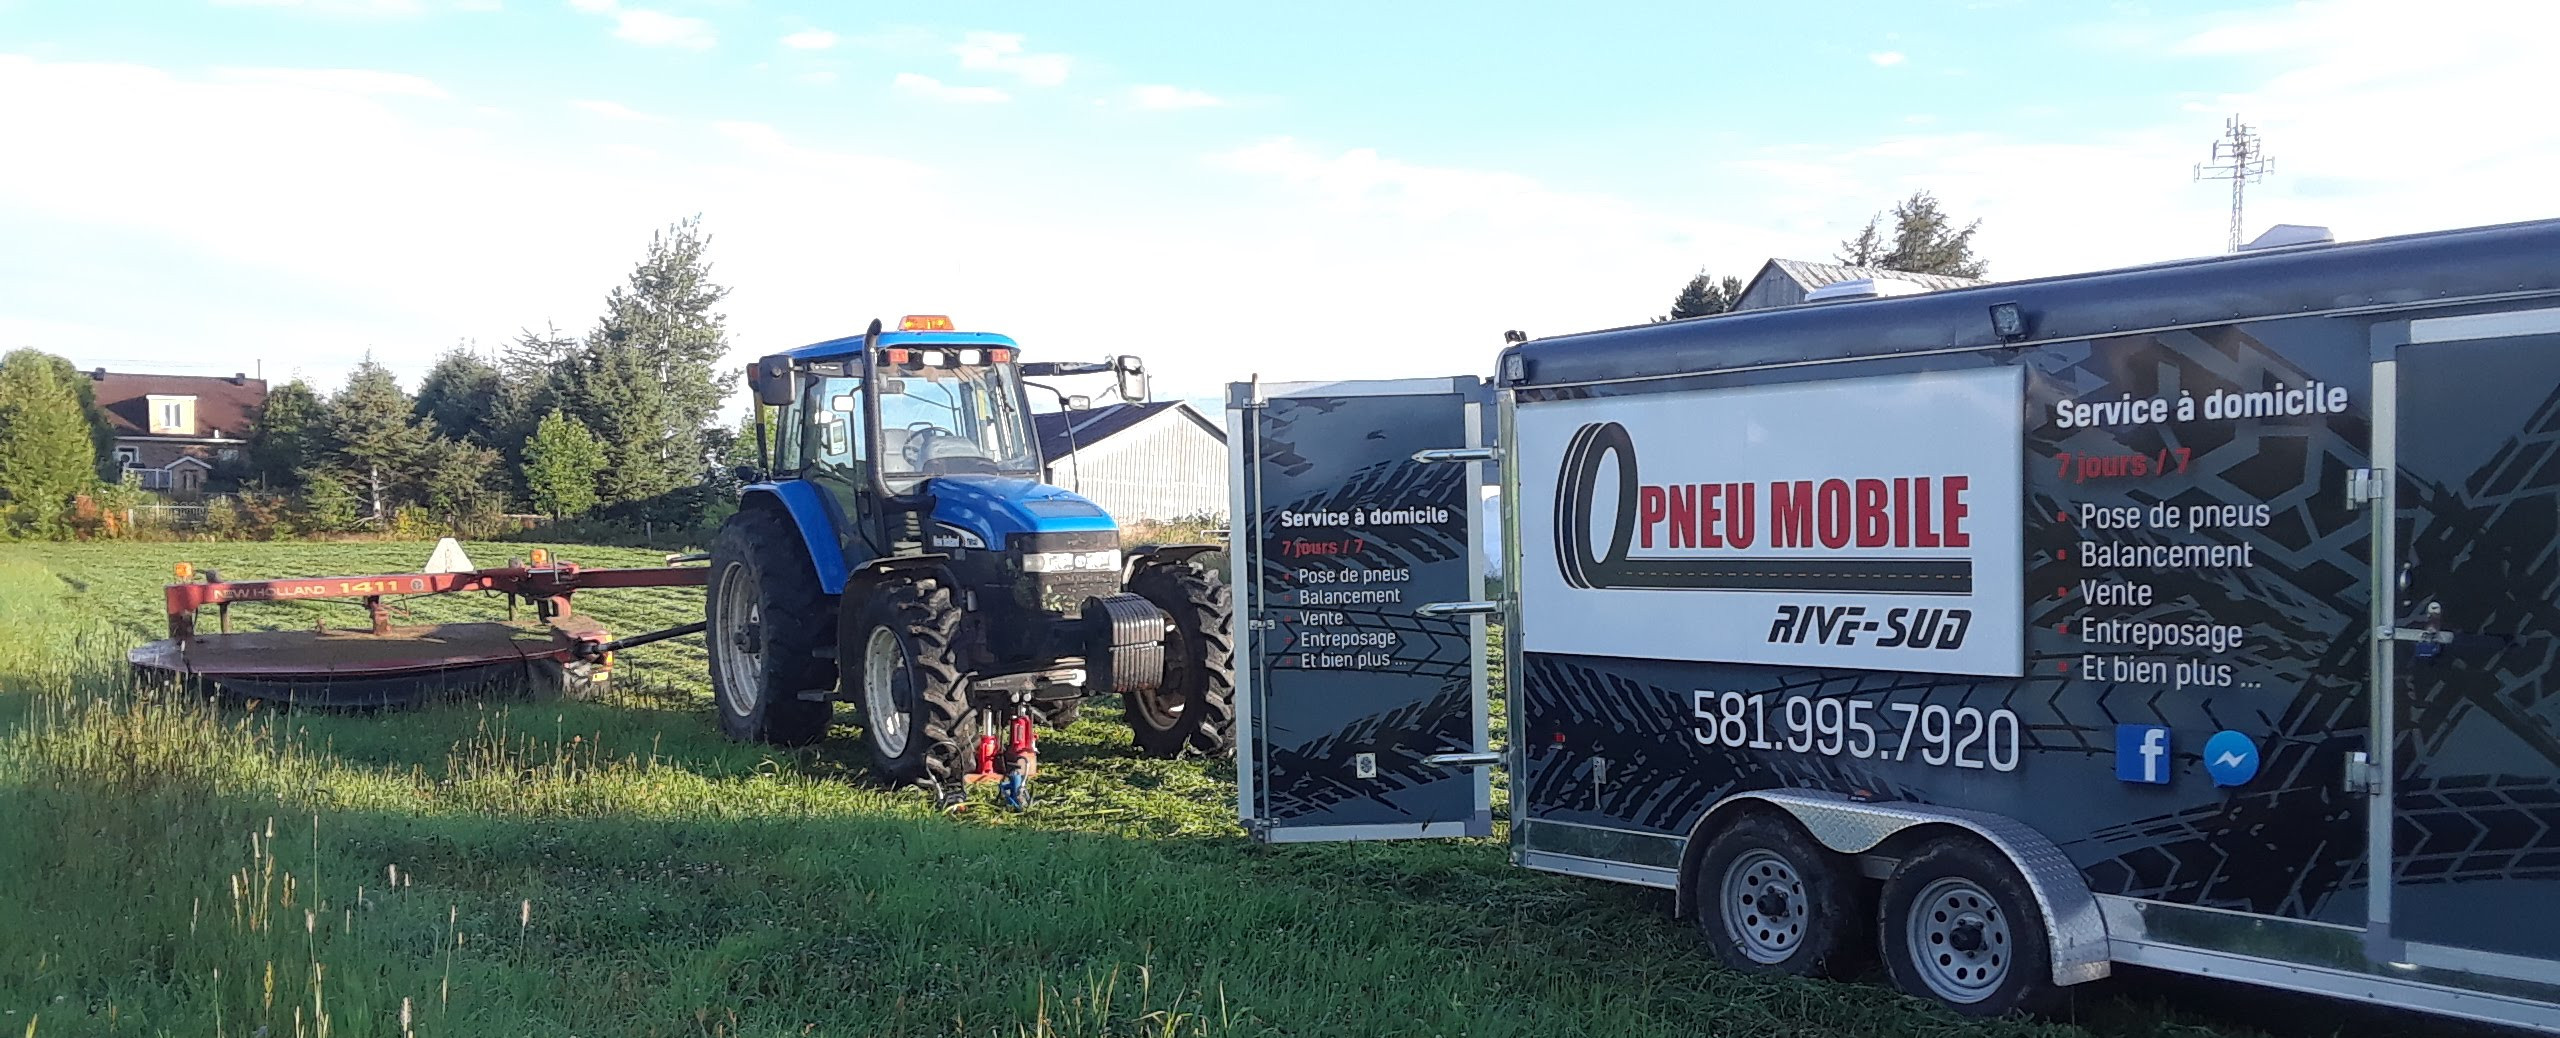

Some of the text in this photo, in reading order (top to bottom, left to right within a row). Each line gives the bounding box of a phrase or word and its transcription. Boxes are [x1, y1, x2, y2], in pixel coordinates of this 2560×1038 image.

[2056, 380, 2348, 428] Service à domicile
[2056, 447, 2191, 484] 7 jours / 7
[1281, 506, 1449, 527] Service à domicile
[1770, 475, 1971, 550] MOBILE
[2081, 501, 2270, 533] Pose de pneus
[1281, 538, 1364, 558] 7 jours / 7
[2081, 541, 2253, 568] Balancement
[214, 580, 398, 600] NEW HOLLAND 1411
[1300, 568, 1409, 585] Pose de pneus
[1300, 588, 1401, 605] Balancement
[2080, 579, 2152, 606] Vente
[1300, 610, 1344, 626] Vente
[1767, 605, 1973, 651] RIVE-SUD
[1301, 632, 1397, 649] Entreposage
[2082, 617, 2243, 653] Entreposage
[1301, 653, 1317, 668] Et
[1321, 652, 1353, 668] bien
[1358, 653, 1391, 670] plus
[2082, 655, 2105, 681] Et
[2114, 655, 2167, 683] bien
[2176, 658, 2232, 690] plus
[1693, 690, 2020, 772] 581.995.7920
